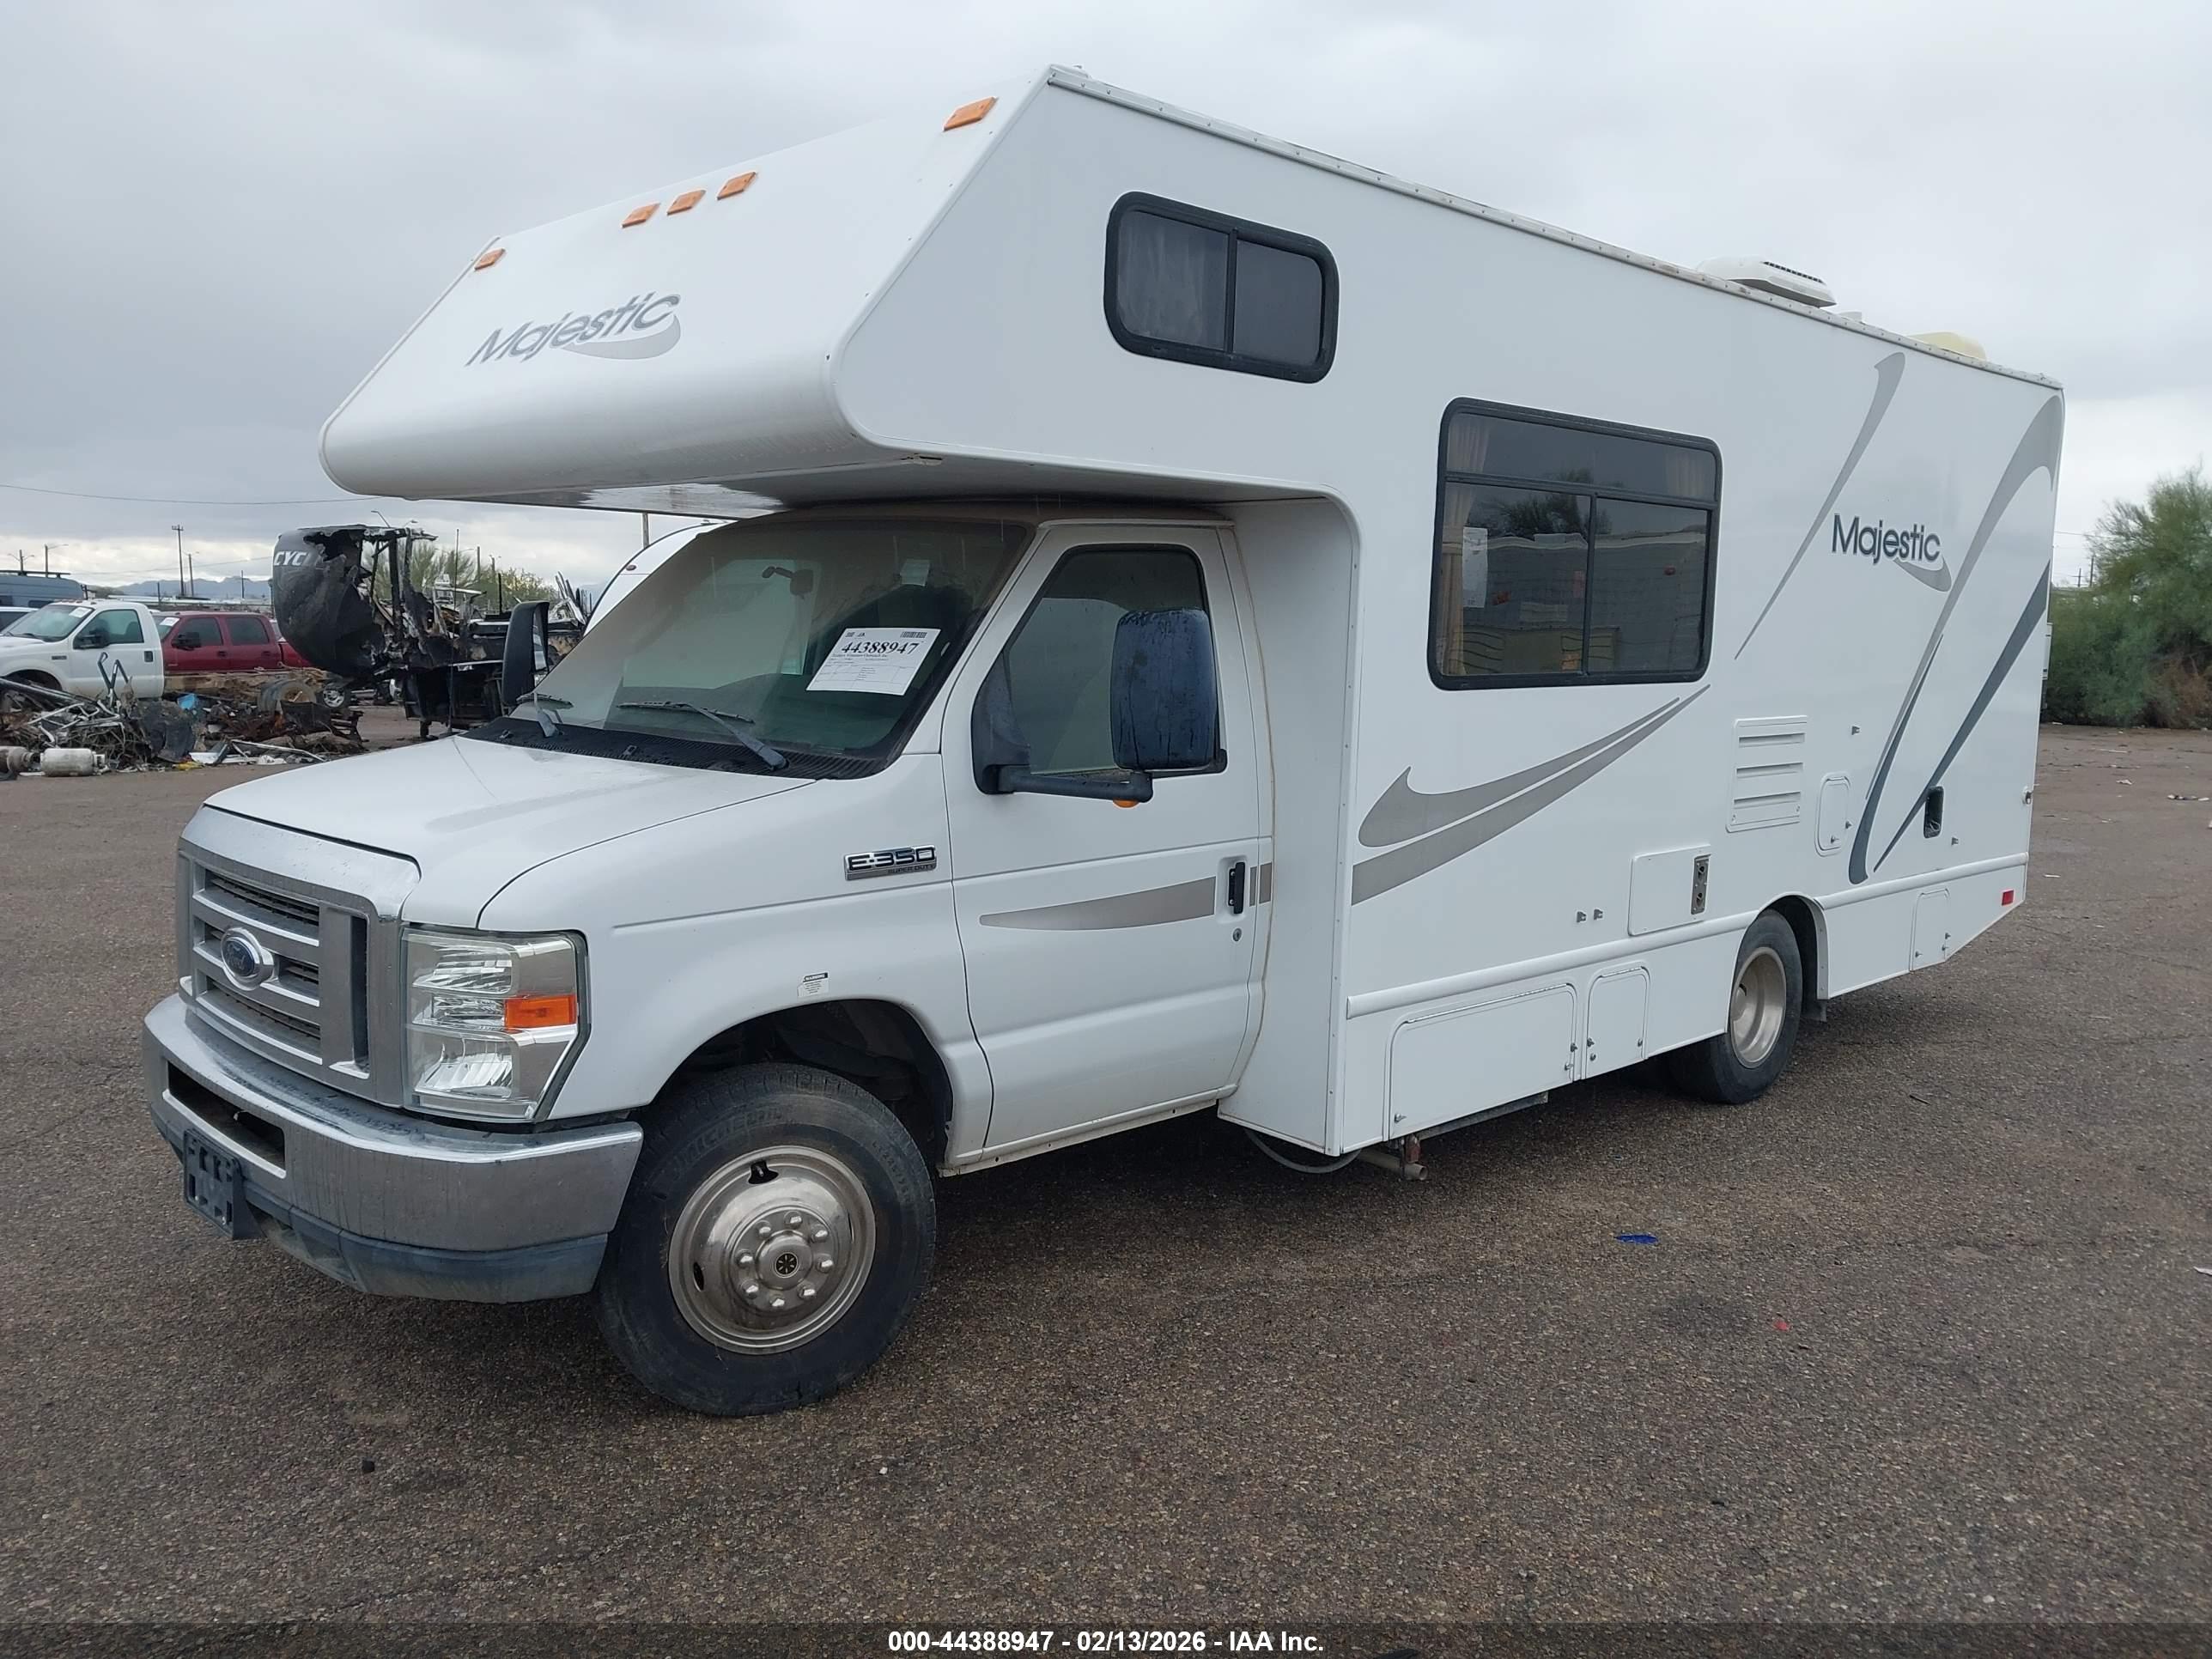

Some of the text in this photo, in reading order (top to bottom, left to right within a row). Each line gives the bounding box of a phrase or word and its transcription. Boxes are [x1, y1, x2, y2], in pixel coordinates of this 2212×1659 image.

[464, 290, 682, 367] Majestic
[1832, 513, 1941, 565] Majestic
[841, 641, 920, 655] 44388947
